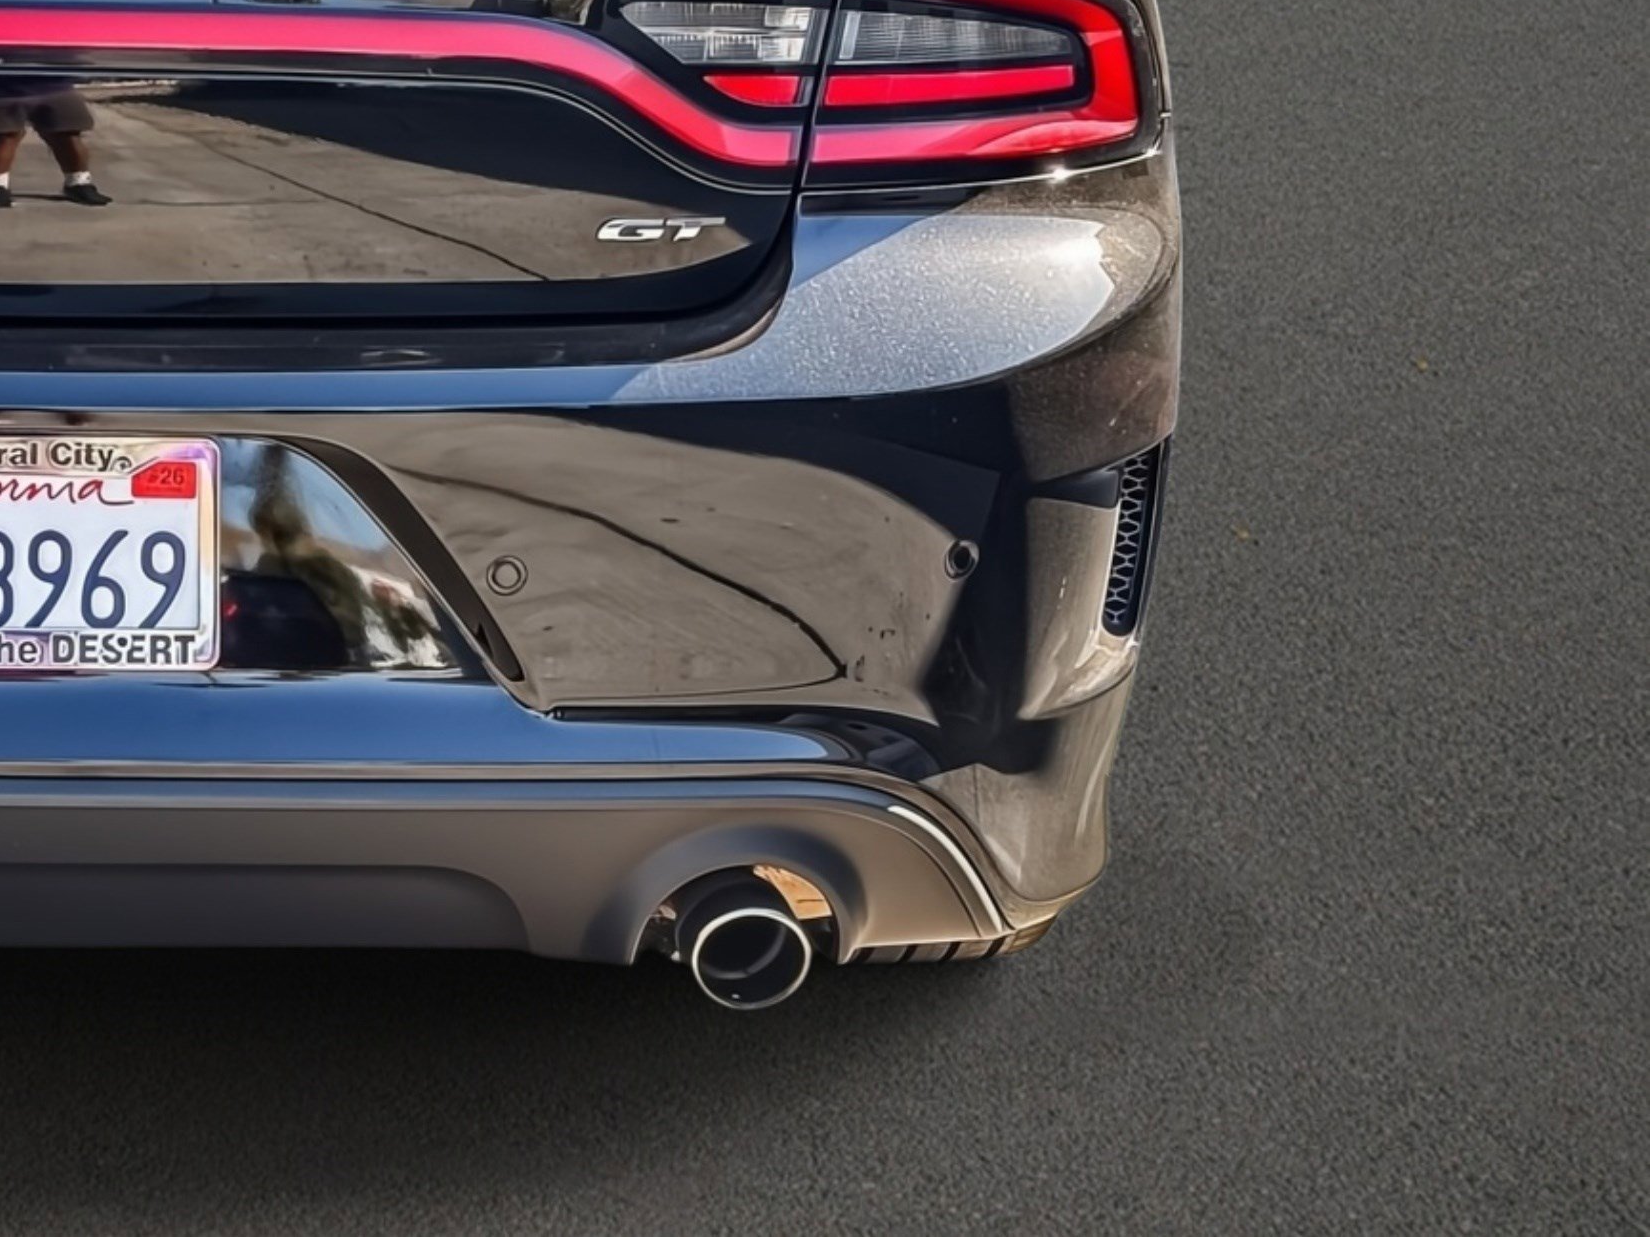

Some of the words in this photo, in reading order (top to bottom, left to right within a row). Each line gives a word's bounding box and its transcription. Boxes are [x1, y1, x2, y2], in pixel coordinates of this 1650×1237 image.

[597, 216, 726, 242] GT
[50, 442, 114, 473] City
[52, 634, 195, 664] DESERT
